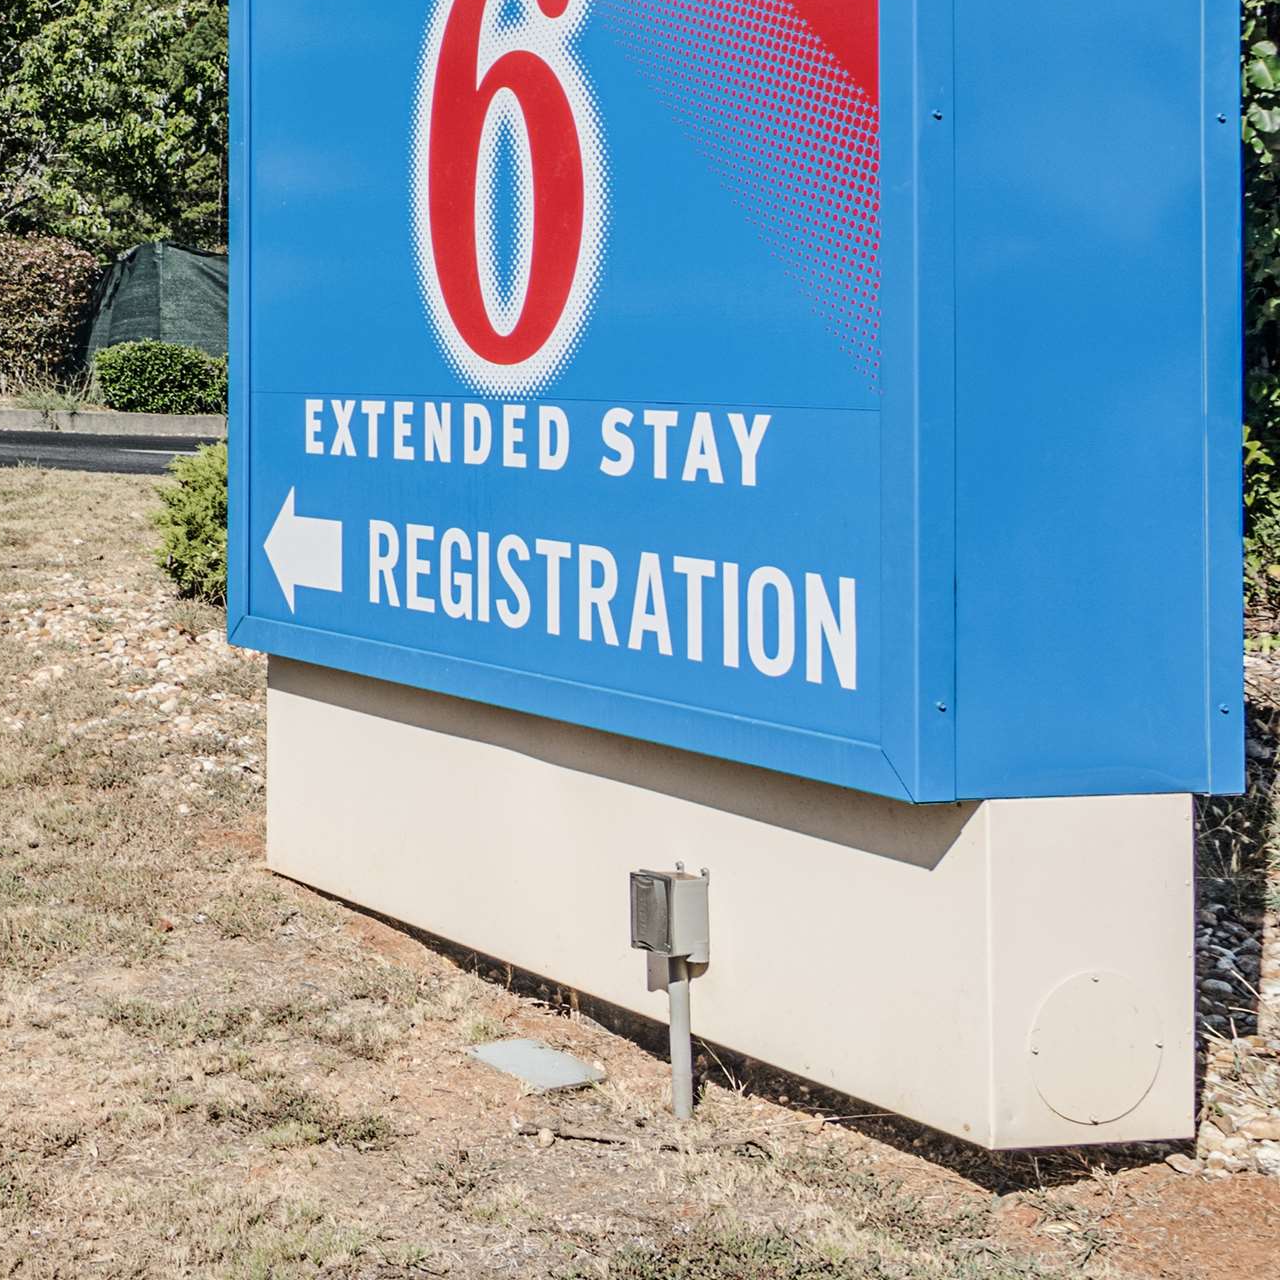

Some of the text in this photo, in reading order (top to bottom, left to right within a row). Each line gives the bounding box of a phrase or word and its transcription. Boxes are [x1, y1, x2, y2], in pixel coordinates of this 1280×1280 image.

[303, 398, 773, 488] EXTENDED STAY
[367, 519, 859, 692] REGISTRATION
